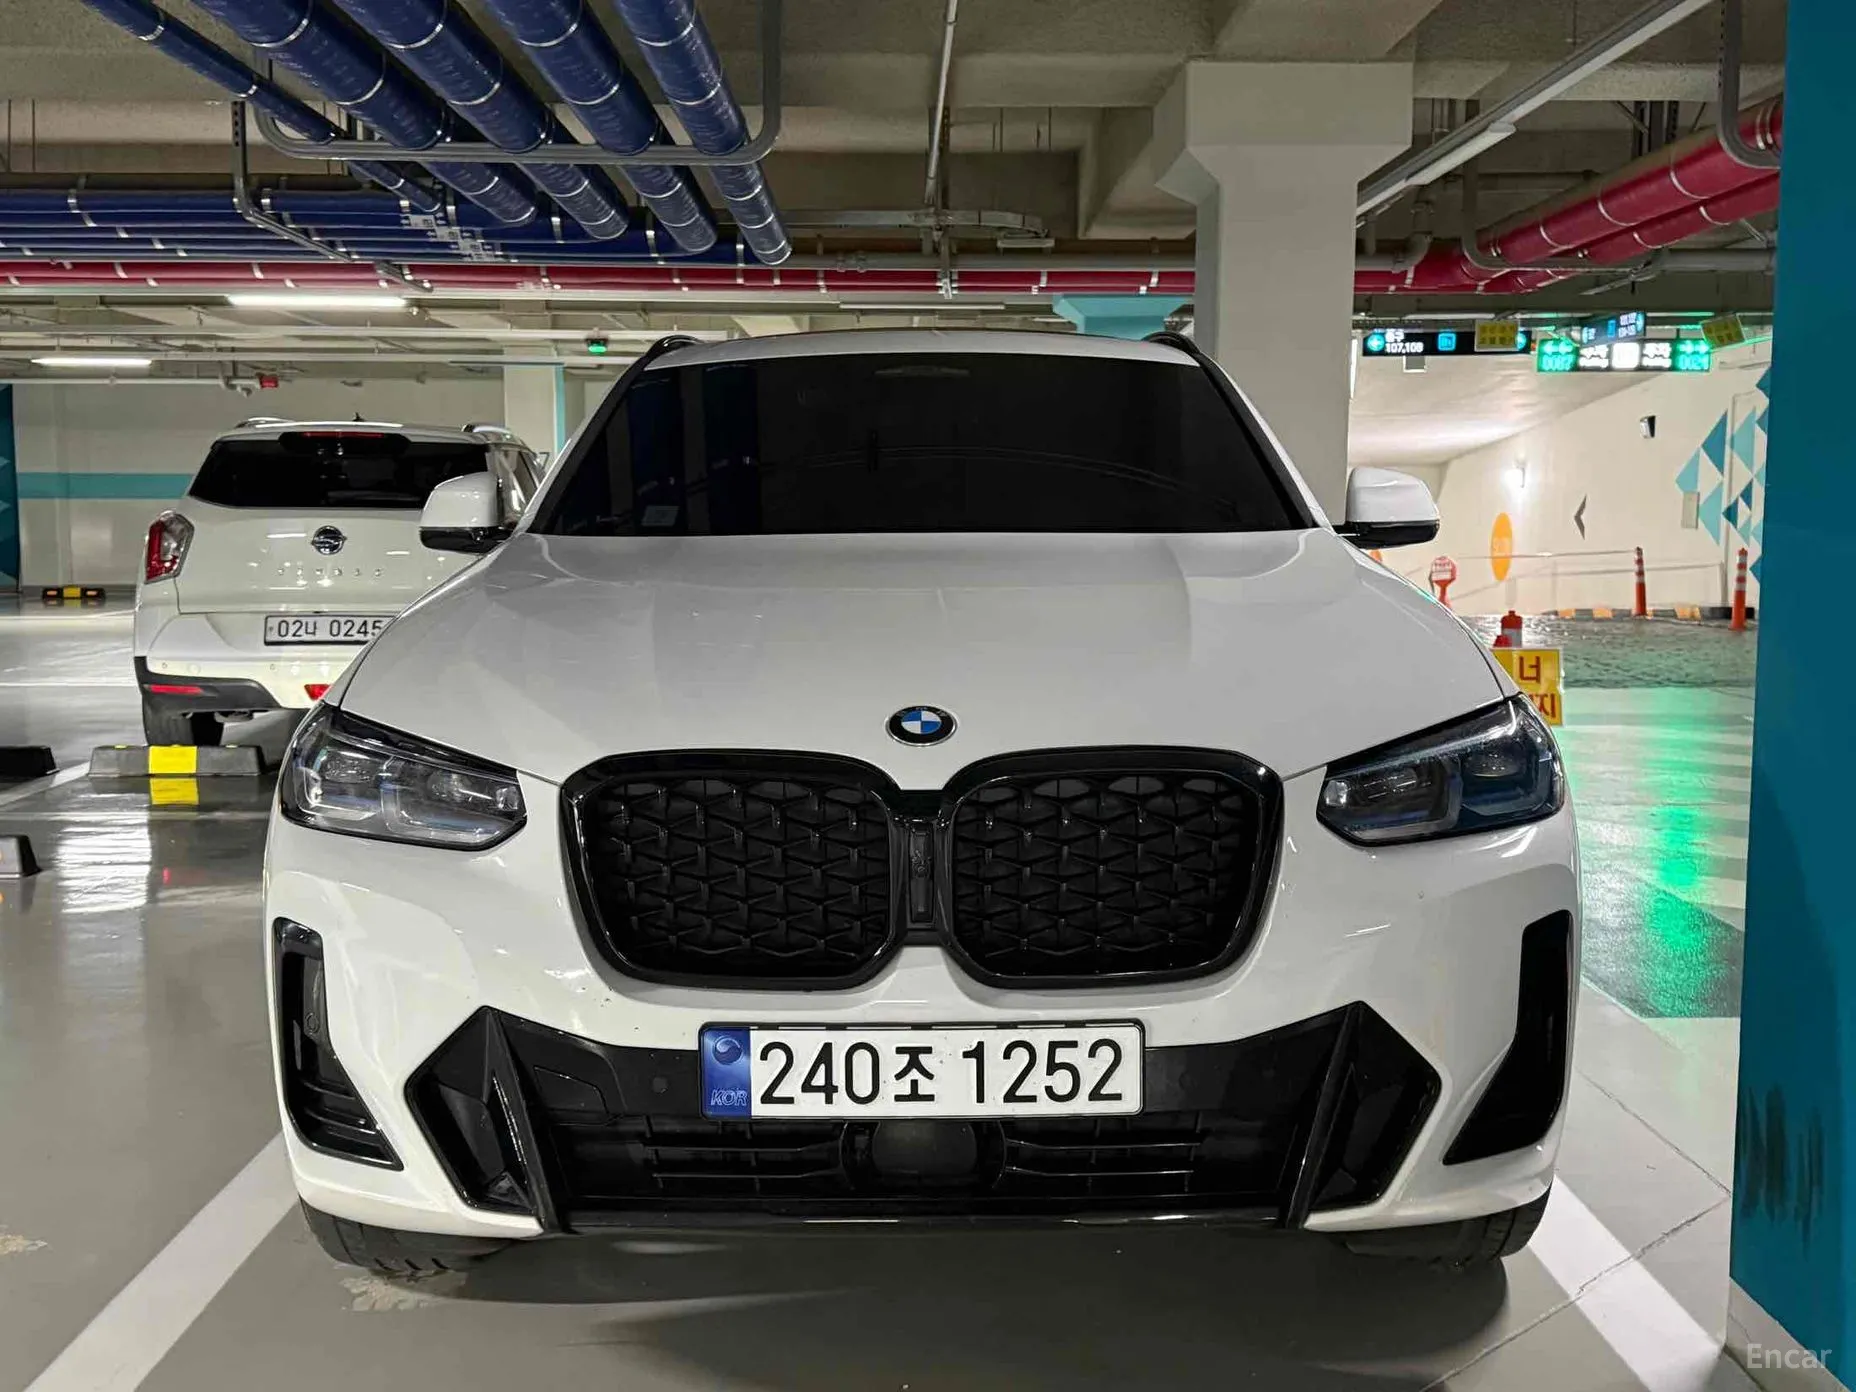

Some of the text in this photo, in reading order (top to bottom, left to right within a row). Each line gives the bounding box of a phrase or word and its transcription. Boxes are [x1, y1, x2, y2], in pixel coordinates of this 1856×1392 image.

[329, 619, 384, 638] 0245
[759, 1038, 1123, 1105] 240조 1252
[710, 1088, 748, 1106] KOR
